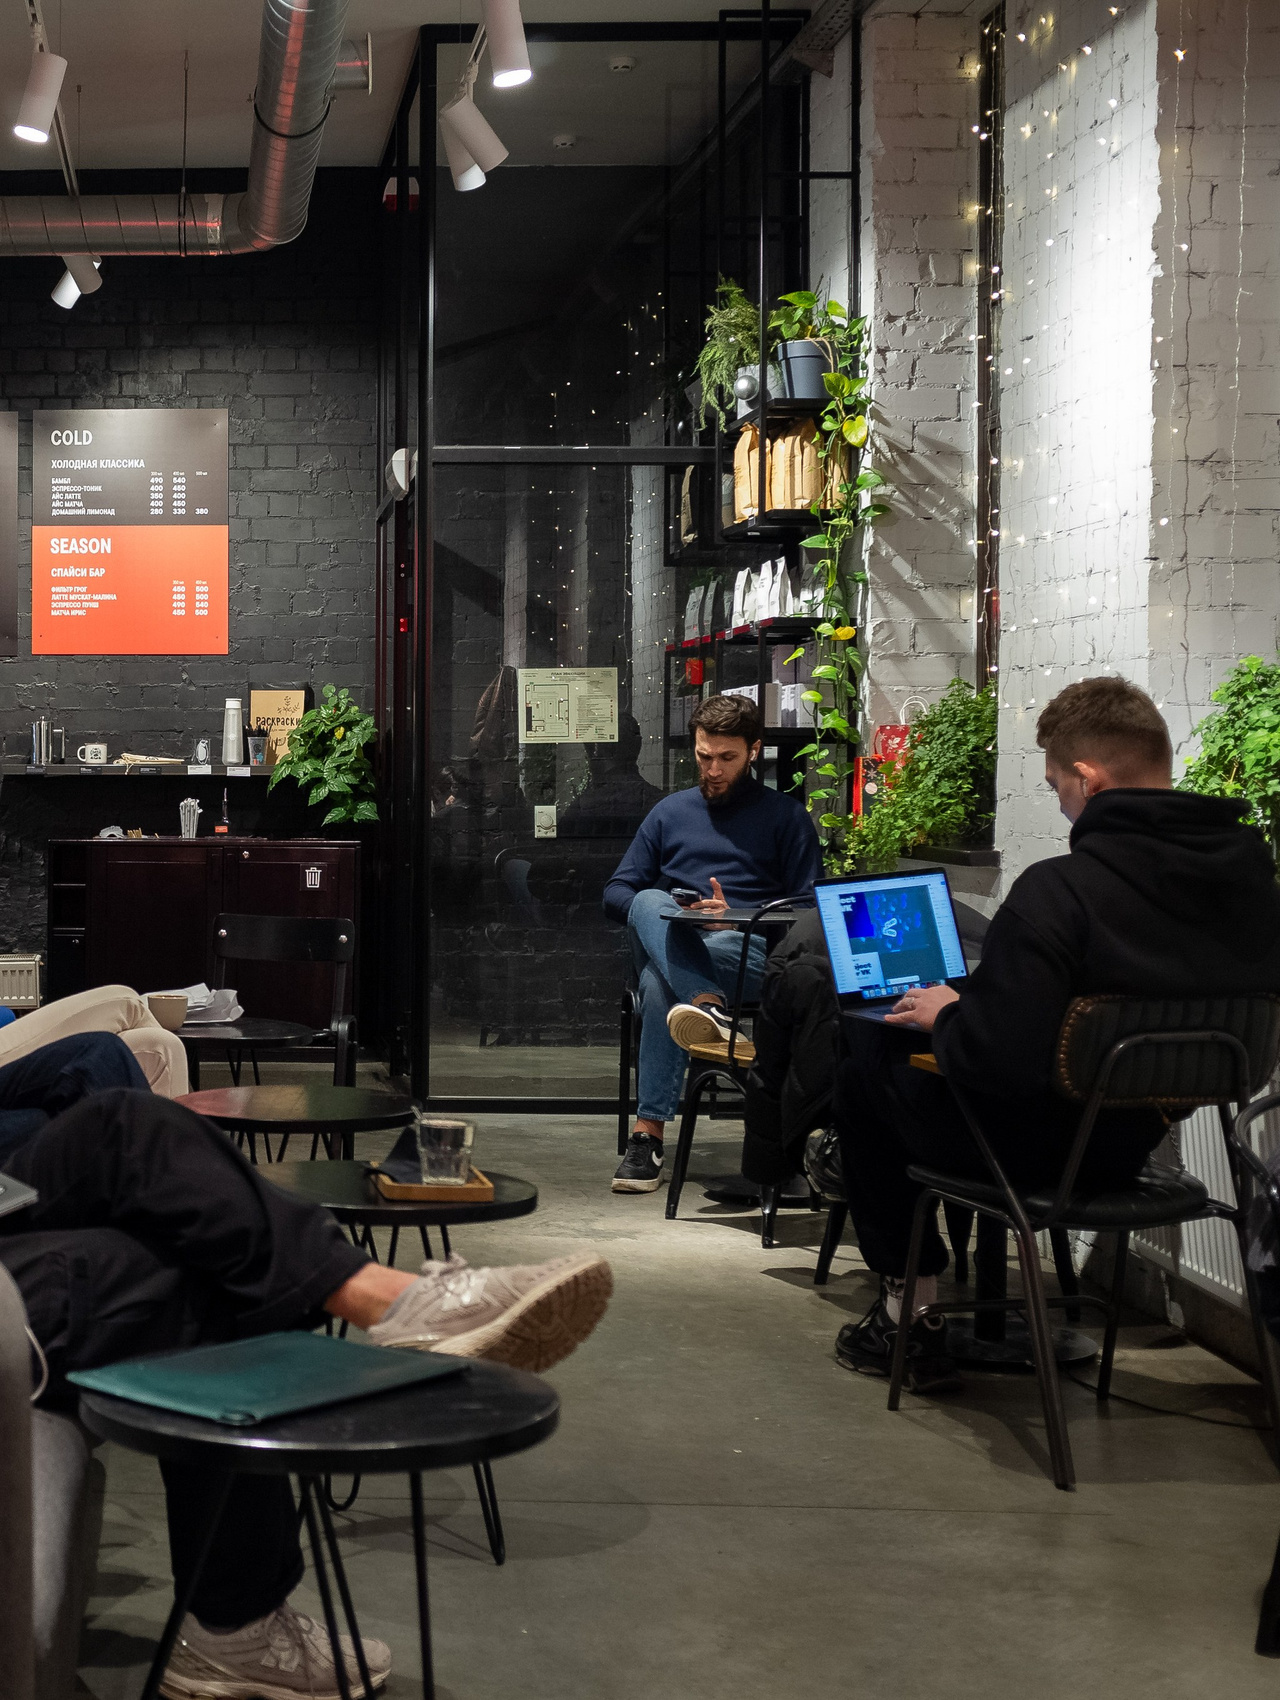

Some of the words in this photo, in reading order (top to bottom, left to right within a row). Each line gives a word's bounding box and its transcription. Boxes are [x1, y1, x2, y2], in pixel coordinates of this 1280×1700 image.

[51, 430, 93, 445] COLD
[52, 460, 97, 470] ХОЛОДНАЯ
[100, 459, 145, 468] КЛАССИКА
[51, 538, 111, 554] SEASON
[51, 566, 87, 577] СПАЙСИ
[89, 568, 105, 577] БАР
